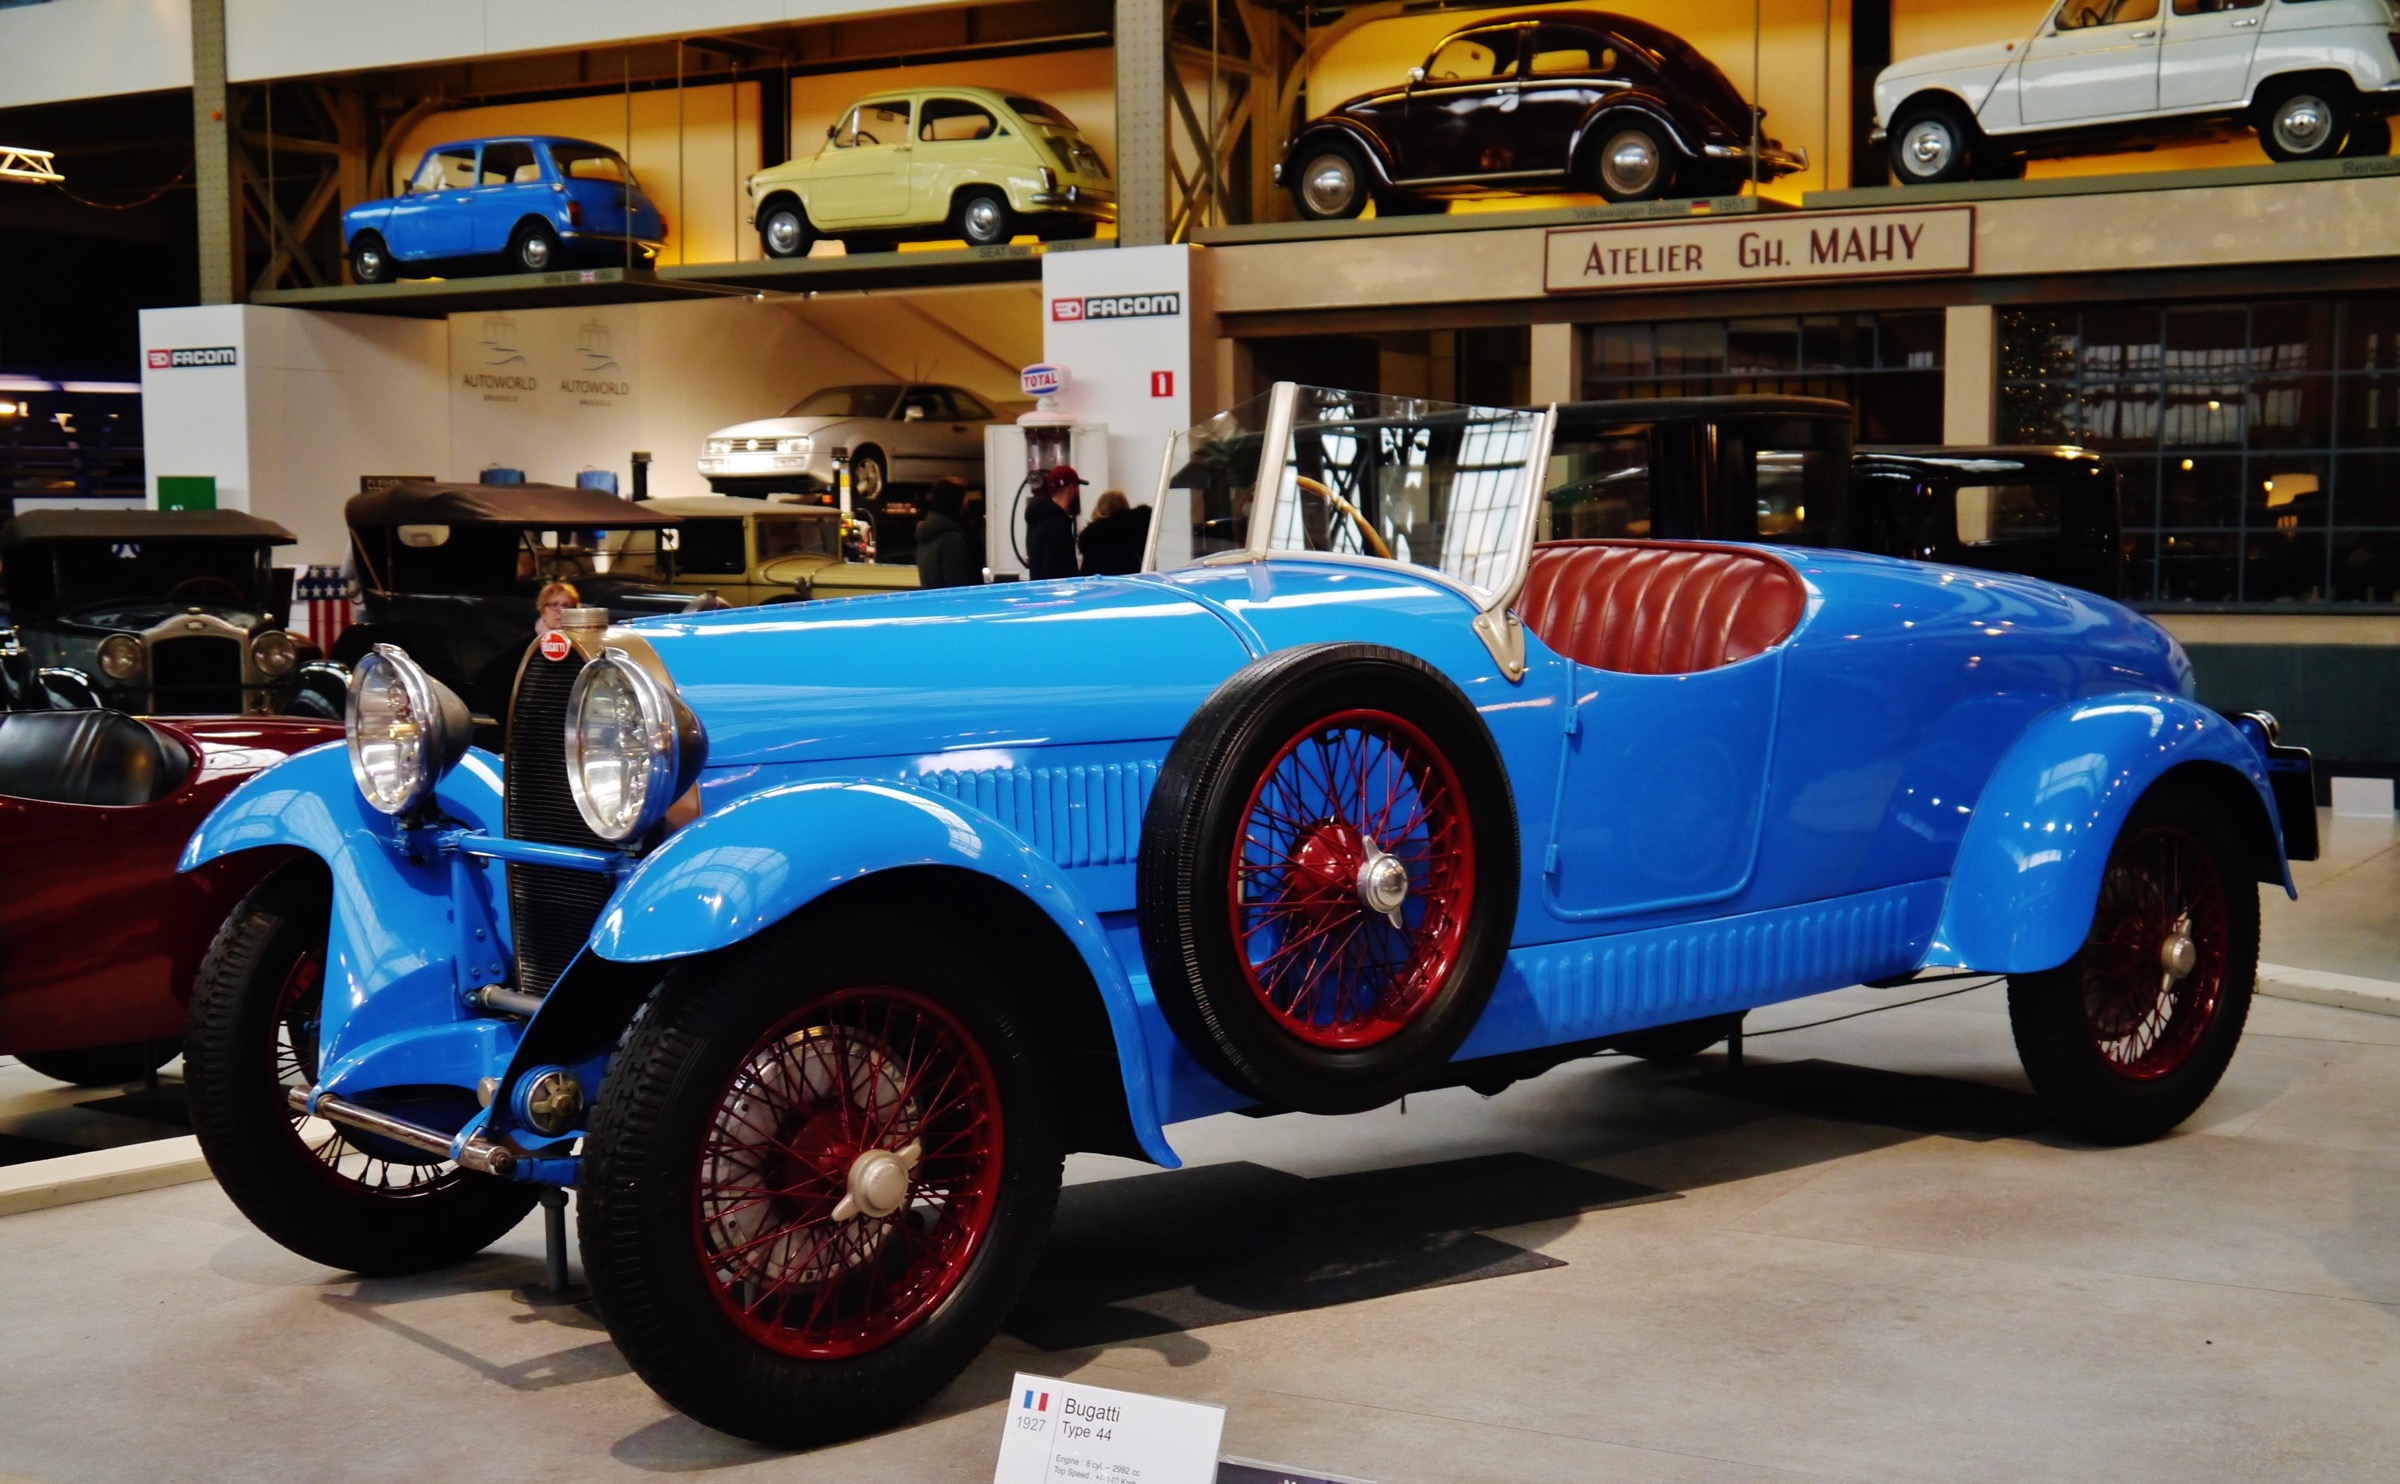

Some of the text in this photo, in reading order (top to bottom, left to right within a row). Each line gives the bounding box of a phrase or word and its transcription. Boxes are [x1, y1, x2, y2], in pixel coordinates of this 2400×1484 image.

[1647, 203, 1686, 216] Beetle
[1718, 199, 1746, 212] 1951
[980, 246, 1006, 258] SEAT
[1583, 241, 1703, 276] ATELIER
[1810, 223, 1924, 264] MAHY
[1087, 294, 1178, 317] FACOM
[172, 349, 235, 366] FACOM
[463, 374, 537, 391] AUTOWORLD
[560, 380, 629, 396] AUTOWORLD
[1023, 373, 1057, 388] TOTAL
[1065, 1398, 1121, 1422] Bugatti
[1017, 1416, 1047, 1432] 1927
[1062, 1421, 1112, 1441] Type 44
[1054, 1465, 1066, 1475] Top
[1067, 1468, 1090, 1480] Speed
[1056, 1454, 1079, 1465] Engine
[1112, 1464, 1130, 1475] 2992
